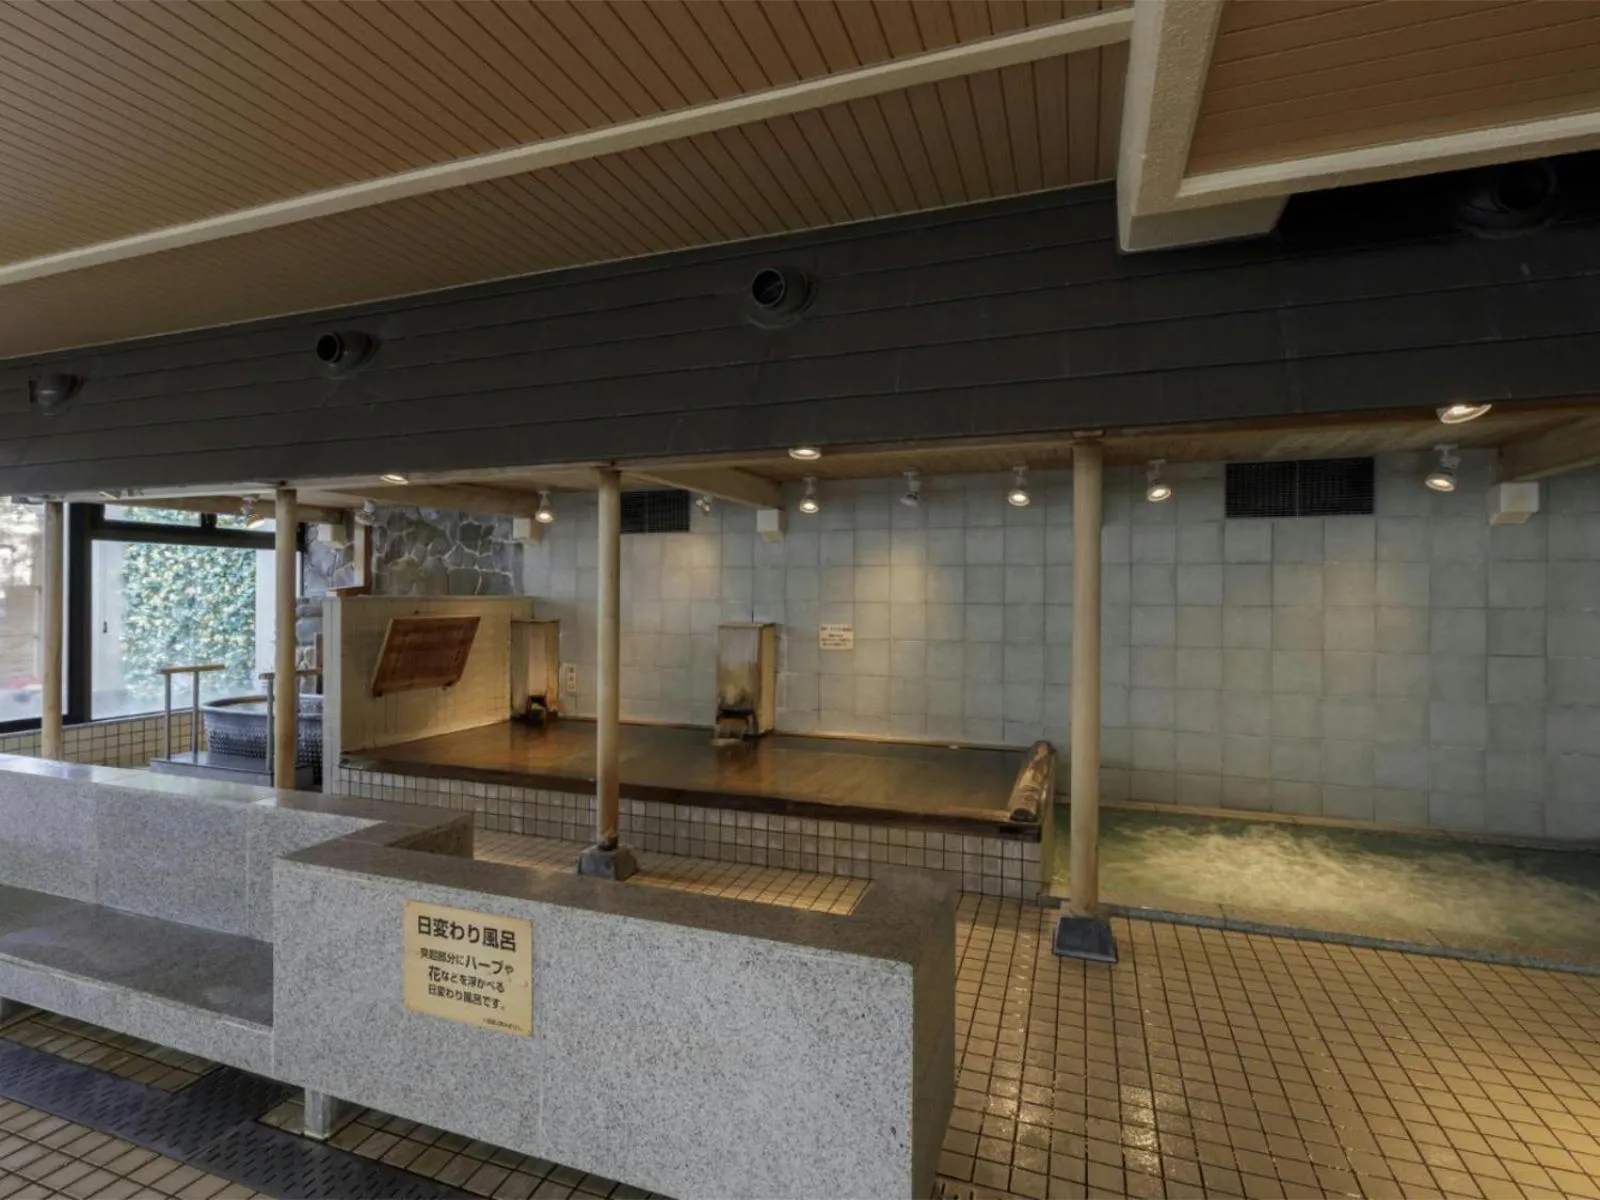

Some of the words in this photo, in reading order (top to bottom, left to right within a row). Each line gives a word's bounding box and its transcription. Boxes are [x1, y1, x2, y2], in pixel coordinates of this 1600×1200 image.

[418, 915, 516, 952] 日変わり風呂
